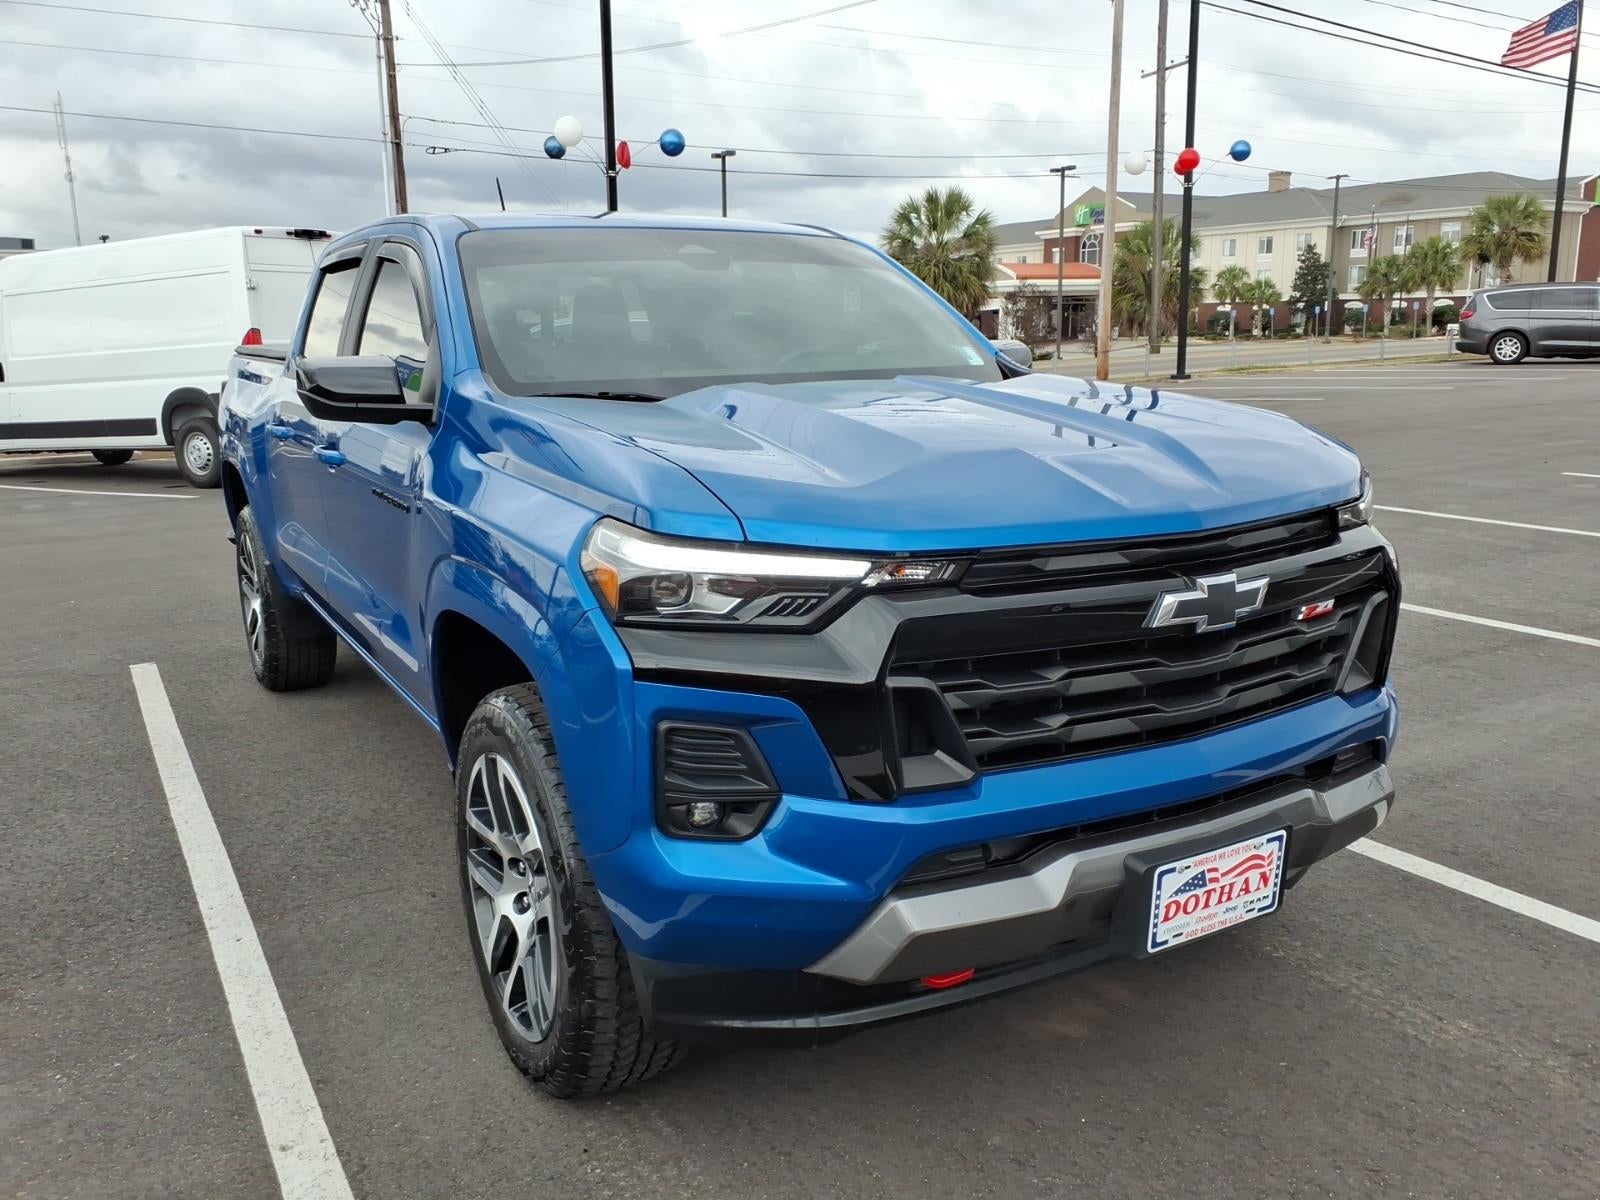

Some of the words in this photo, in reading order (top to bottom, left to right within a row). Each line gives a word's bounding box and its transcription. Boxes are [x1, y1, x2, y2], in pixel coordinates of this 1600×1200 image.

[1218, 851, 1226, 860] WE
[1160, 868, 1274, 924] DOTHAN
[1249, 894, 1270, 905] RAM
[1223, 905, 1239, 914] Jeep
[1195, 911, 1218, 924] Dodge
[1184, 928, 1200, 939] GOD
[1200, 923, 1216, 935] BLESS
[1217, 919, 1228, 928] THE
